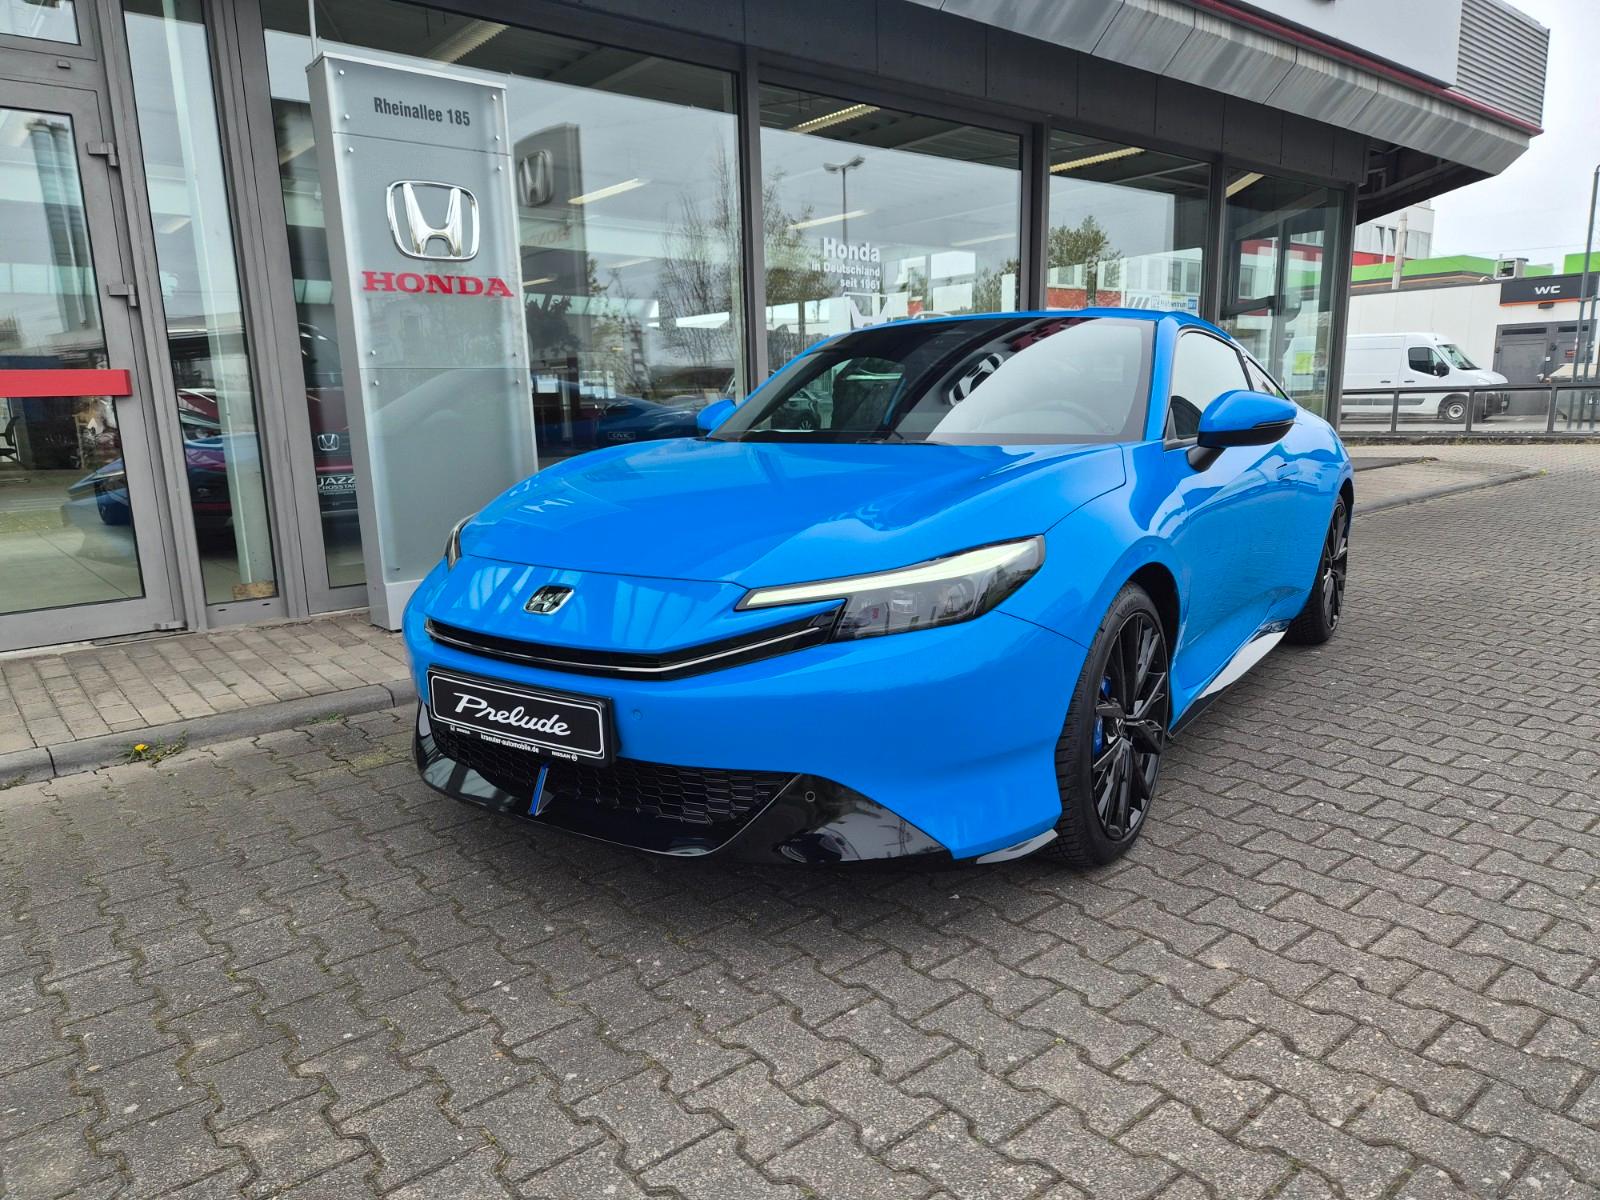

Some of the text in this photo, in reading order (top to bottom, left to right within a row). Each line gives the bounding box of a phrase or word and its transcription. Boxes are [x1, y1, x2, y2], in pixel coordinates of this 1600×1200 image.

[374, 97, 471, 126] Rheinallee 185
[823, 237, 880, 262] Honda
[824, 262, 880, 277] Deutschland
[361, 270, 514, 297] HONDA
[840, 278, 880, 290] seit 1961
[1534, 285, 1561, 294] WC
[318, 476, 356, 488] JAZZ
[453, 692, 571, 736] Prelude
